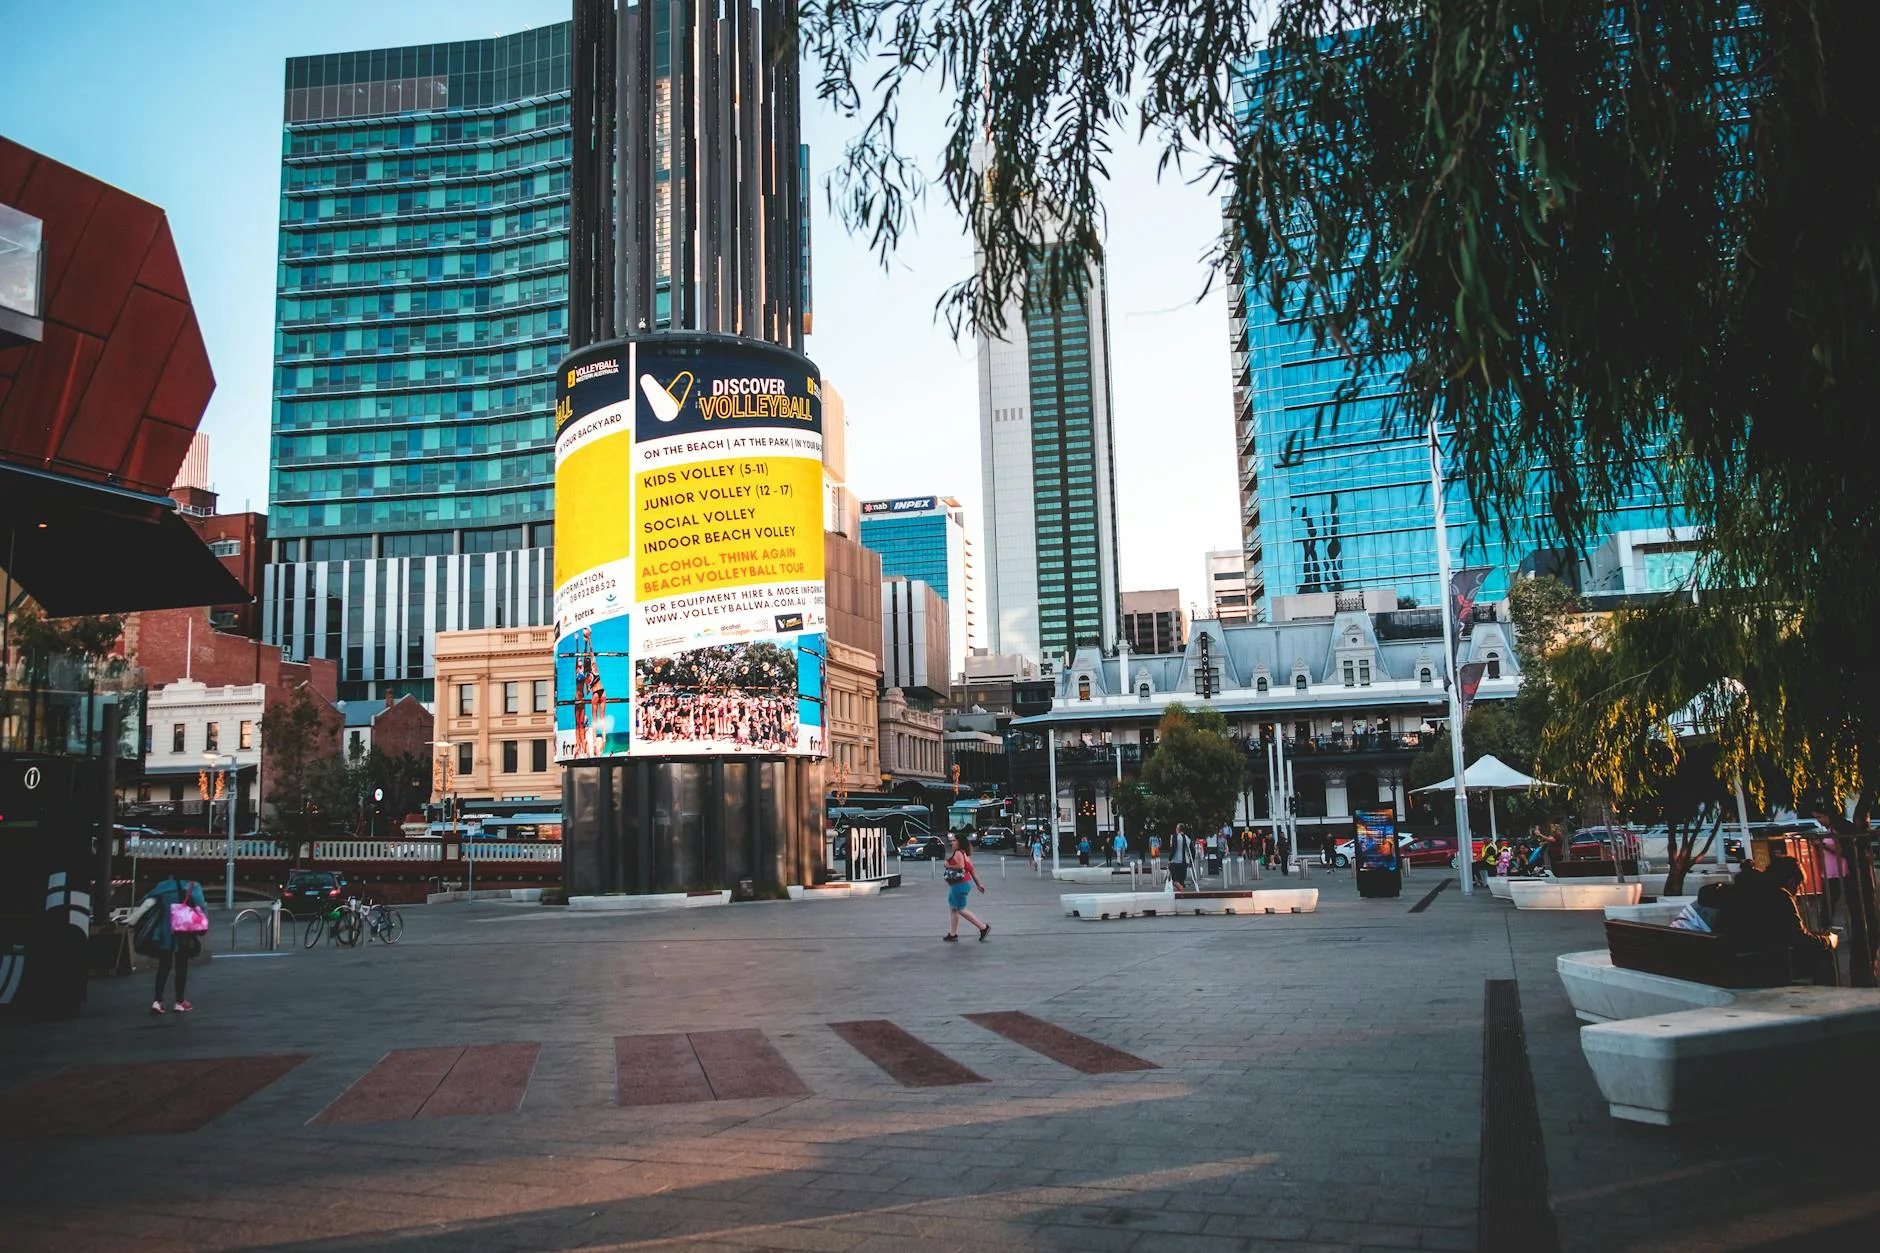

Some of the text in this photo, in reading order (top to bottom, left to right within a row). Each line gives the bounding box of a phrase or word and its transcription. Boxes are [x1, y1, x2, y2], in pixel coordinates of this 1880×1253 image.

[576, 360, 619, 377] VOLLEYBALL
[712, 378, 785, 396] DISCOVER
[699, 395, 813, 421] VOLLEYBALL
[578, 413, 622, 439] BACKYARD
[644, 448, 660, 460] ON
[663, 444, 684, 456] THE
[688, 437, 724, 452] BEACH
[734, 438, 746, 448] AT
[749, 438, 766, 447] THE
[769, 438, 790, 447] PARK
[794, 438, 802, 448] IN
[644, 462, 769, 488] KIDS VOLLEY (5-11)
[644, 492, 694, 511] JUNIOR
[699, 486, 752, 501] VOLLEY
[756, 485, 770, 499] (12
[780, 484, 794, 498] 17)
[894, 500, 930, 510] INPEX
[644, 508, 756, 534] SOCIAL VOLLEY
[644, 526, 796, 554] INDOOR BEACH VOLLEY
[642, 548, 796, 577] ALCOHOL. THINK AGAIN
[644, 563, 804, 594] BEACH VOLLEYBALL TOUR
[644, 604, 666, 614] FOR
[672, 592, 738, 610] EQUIPMENT
[741, 589, 764, 600] HIRE
[768, 588, 774, 596] &
[776, 586, 799, 596] MORE
[646, 597, 806, 625] WWW.VOLLEYBALLWA.COM.AU
[851, 828, 887, 880] PERTH
